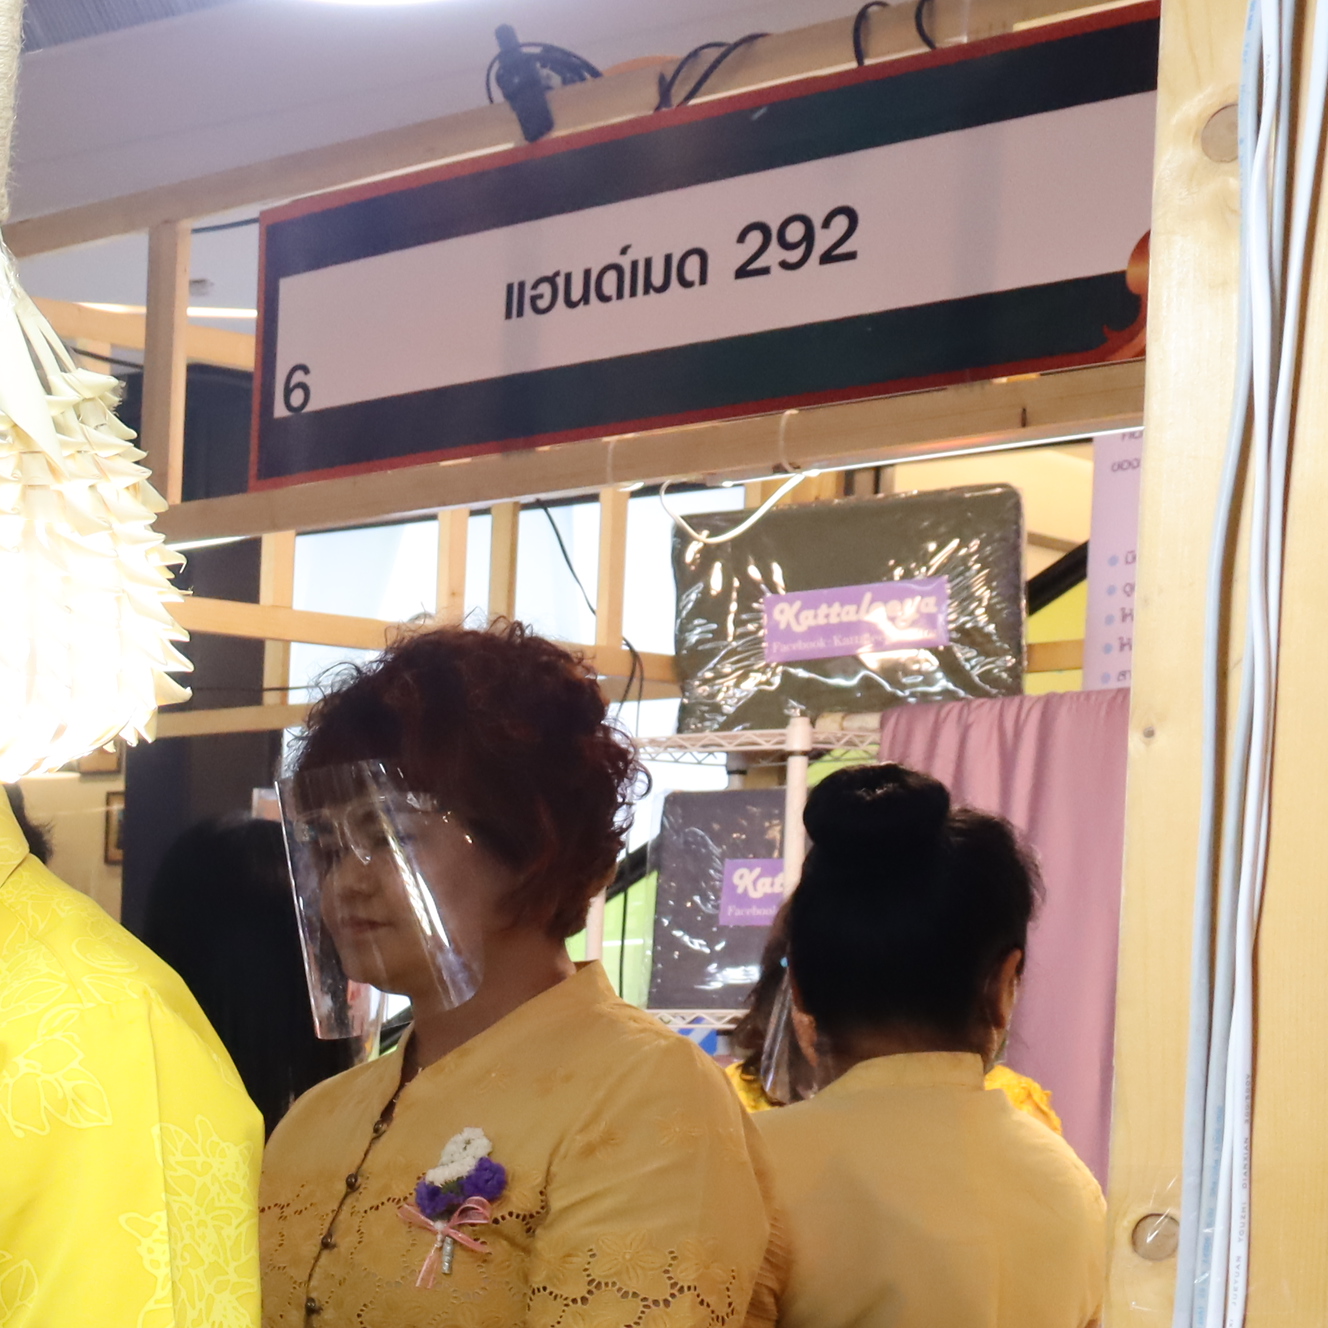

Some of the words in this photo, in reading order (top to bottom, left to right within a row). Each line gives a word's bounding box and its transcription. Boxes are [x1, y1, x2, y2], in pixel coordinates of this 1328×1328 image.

[504, 243, 709, 320] แฮนด์เมด
[733, 204, 859, 280] 292
[283, 363, 311, 413] 6
